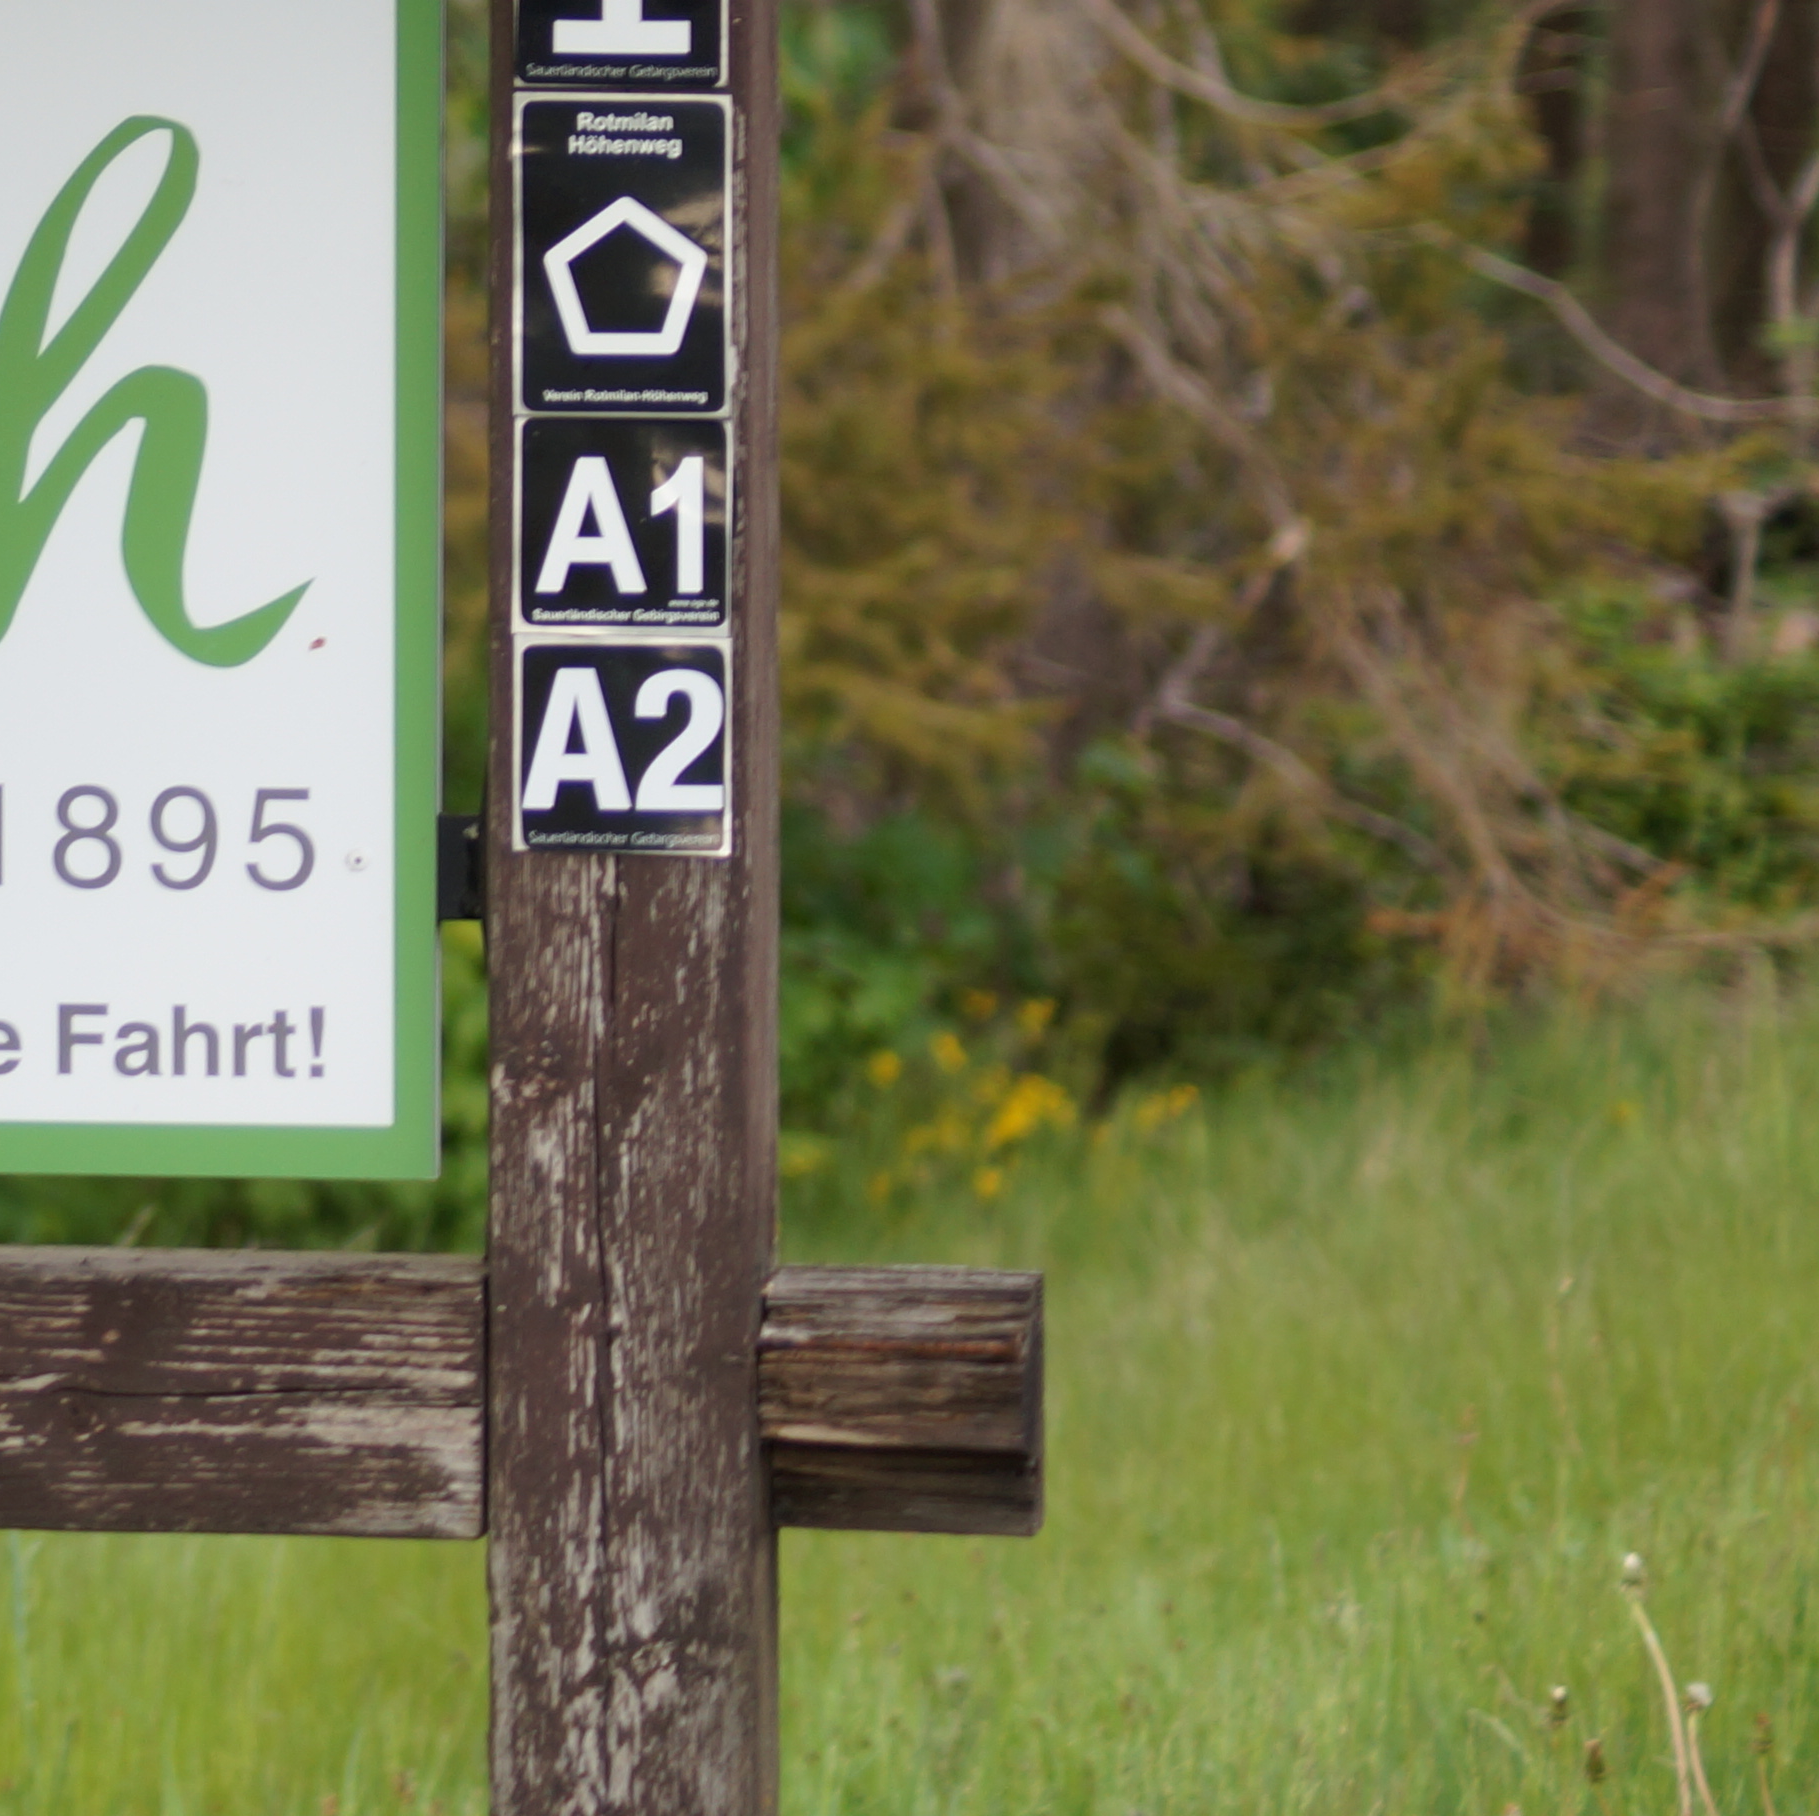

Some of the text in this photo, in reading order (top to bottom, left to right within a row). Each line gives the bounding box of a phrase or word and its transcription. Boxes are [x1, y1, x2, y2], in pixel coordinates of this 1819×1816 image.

[567, 134, 684, 160] Höhenweg
[575, 111, 675, 132] Rotmilan
[535, 456, 704, 595] A1
[521, 666, 726, 812] A2
[55, 1004, 327, 1079] Fahrt!
